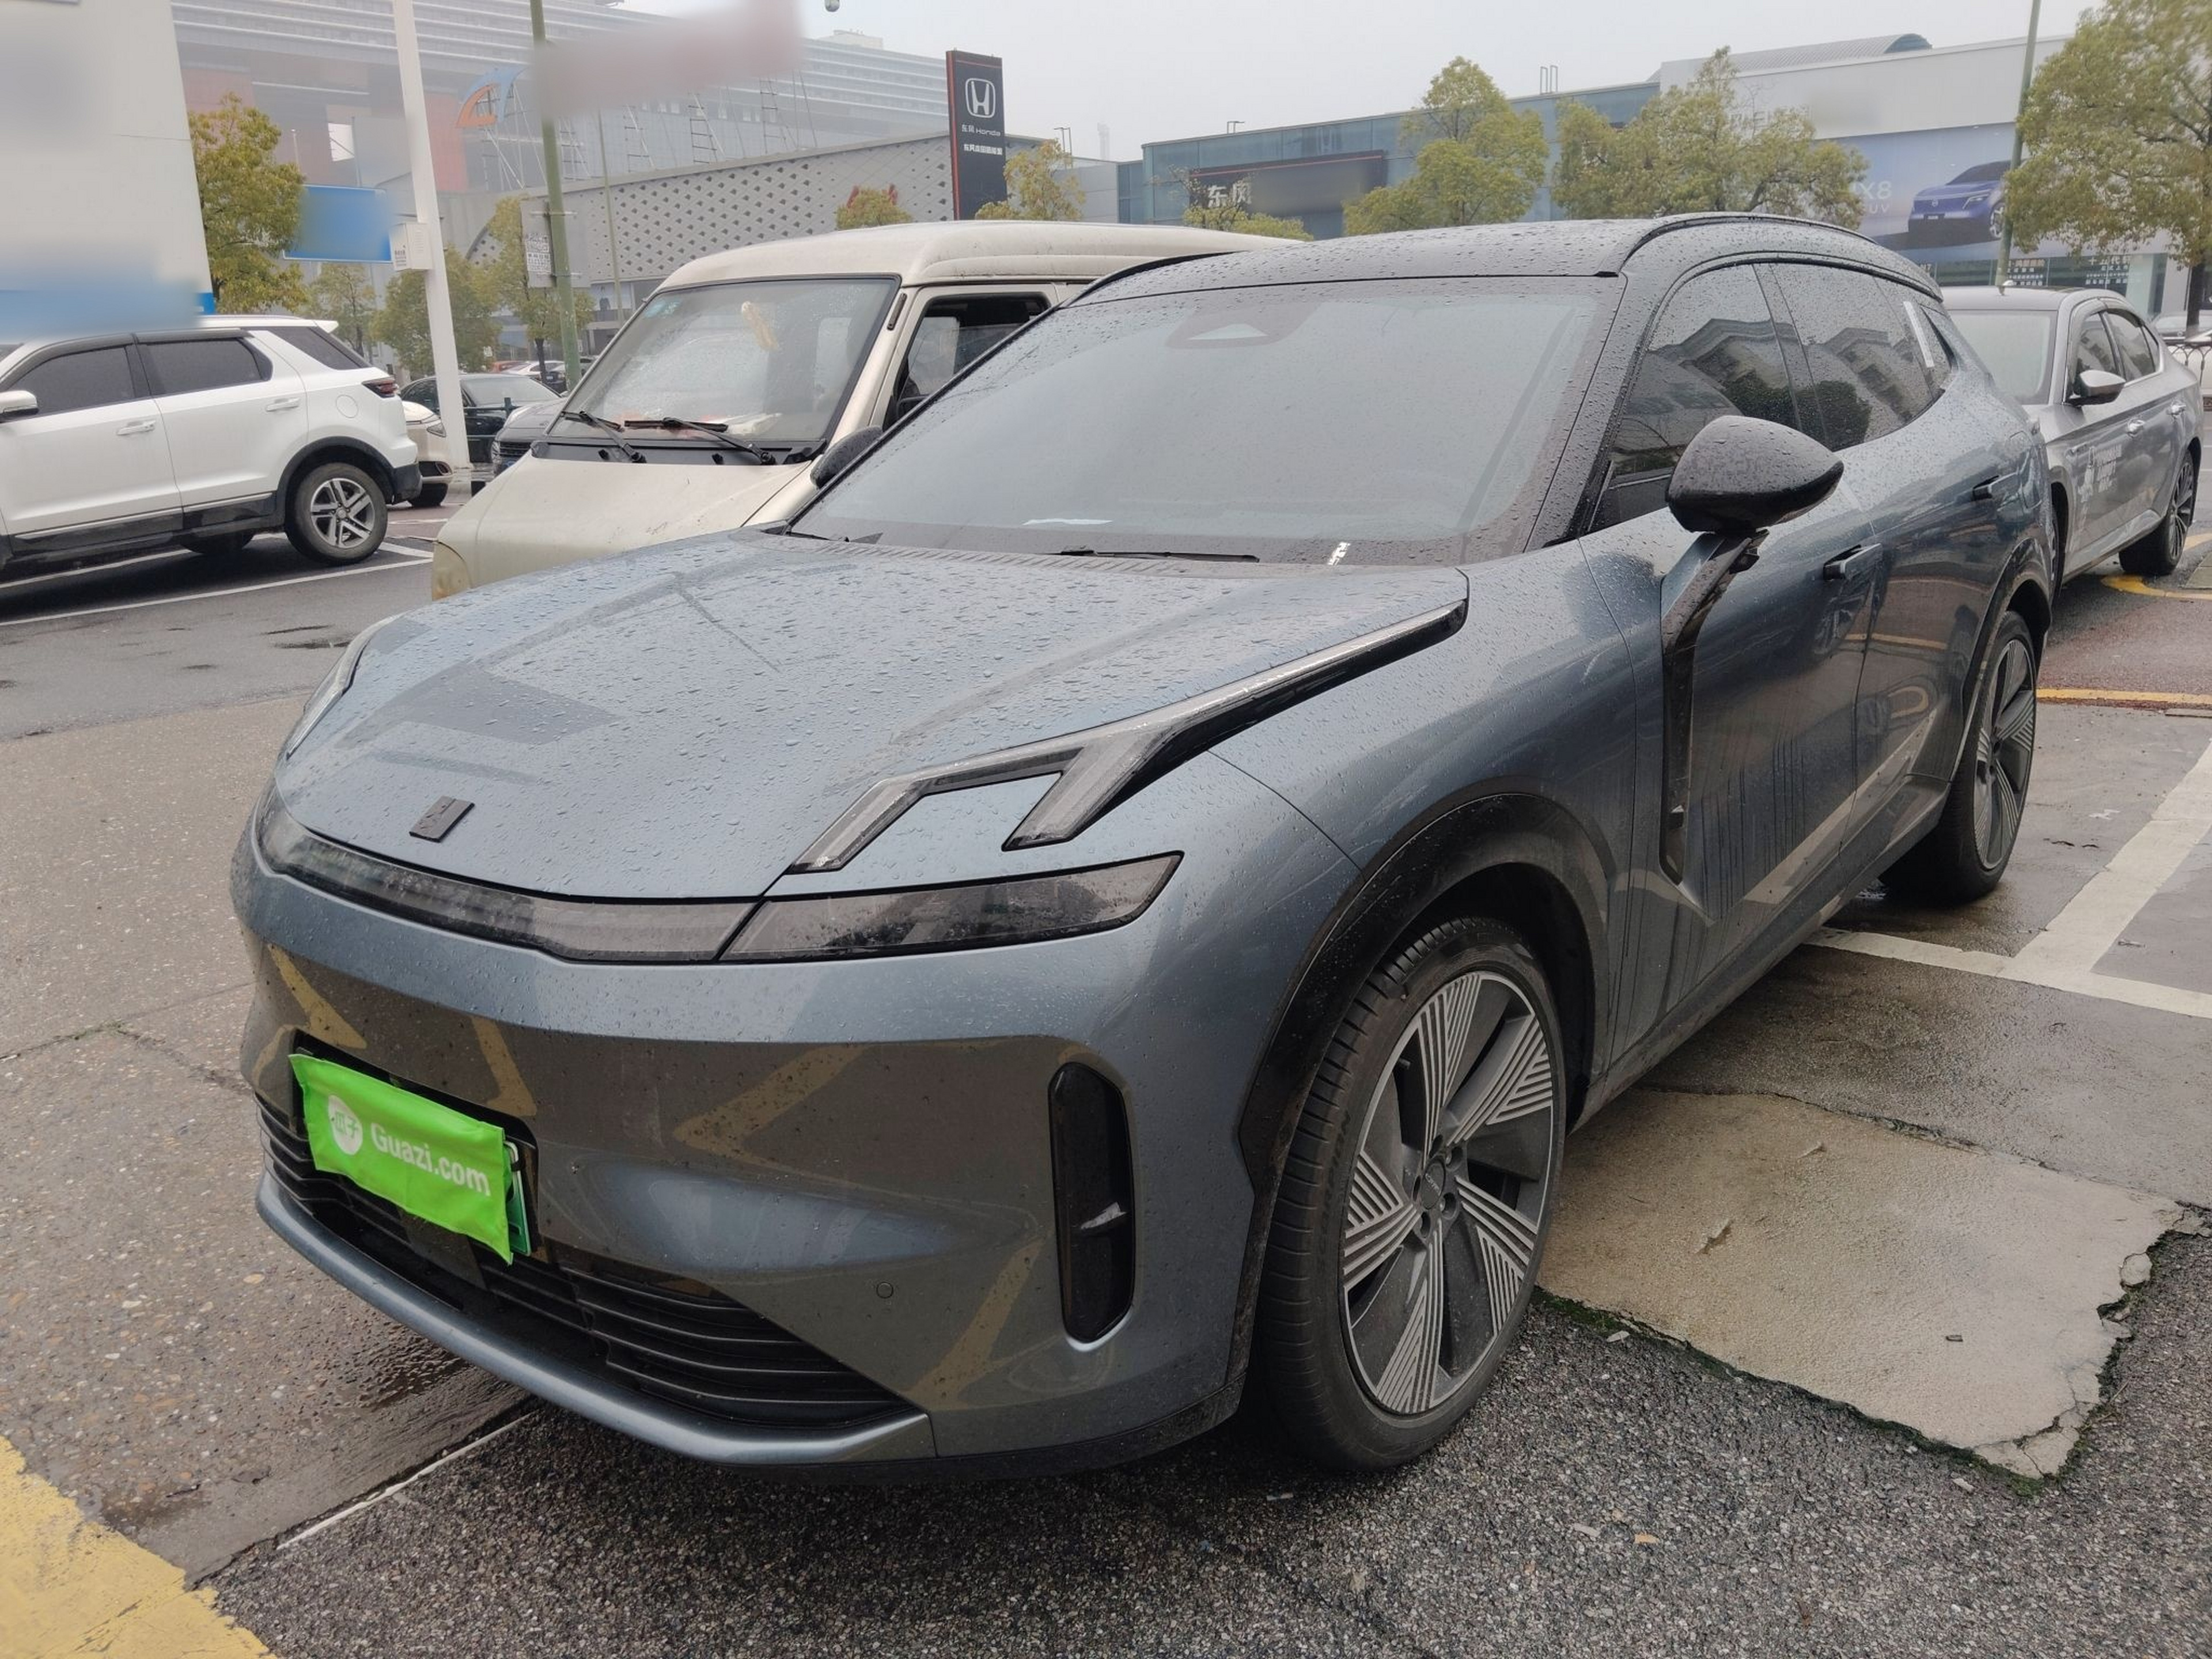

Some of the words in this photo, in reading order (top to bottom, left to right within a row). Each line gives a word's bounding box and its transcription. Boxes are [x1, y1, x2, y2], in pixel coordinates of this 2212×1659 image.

[976, 128, 1001, 136] Honda
[1869, 203, 1890, 214] UV
[370, 1123, 491, 1196] Guazi.com
